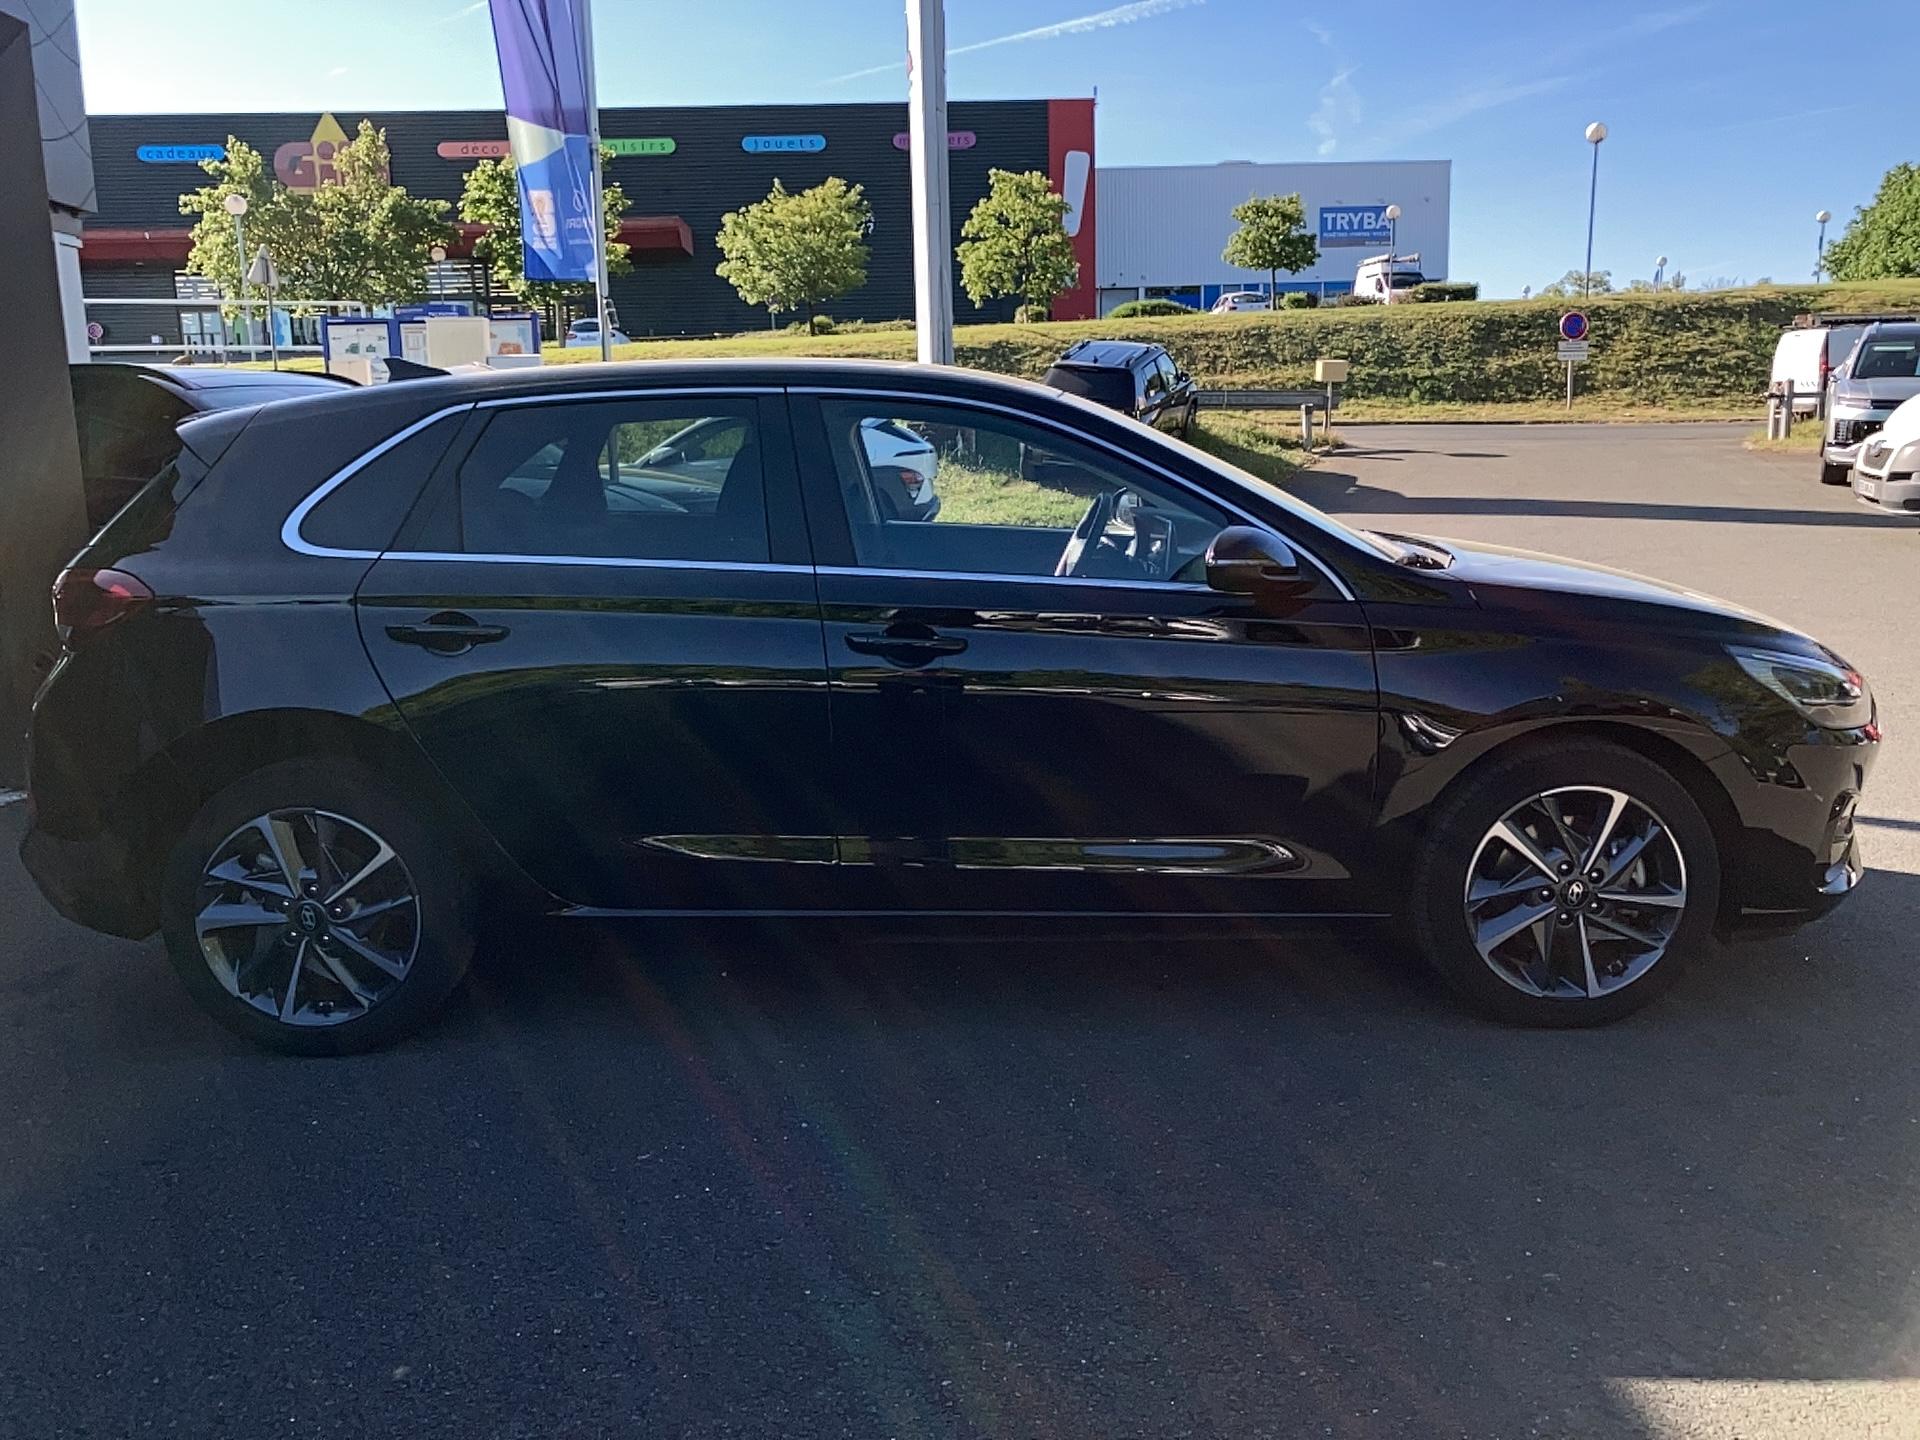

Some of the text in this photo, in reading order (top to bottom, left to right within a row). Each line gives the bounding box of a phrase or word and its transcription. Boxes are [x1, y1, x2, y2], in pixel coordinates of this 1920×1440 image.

[460, 143, 500, 155] déco
[609, 140, 667, 153] oisirs
[753, 138, 816, 151] jouets
[145, 147, 217, 159] cadeaux
[1322, 212, 1391, 231] TRYBA
